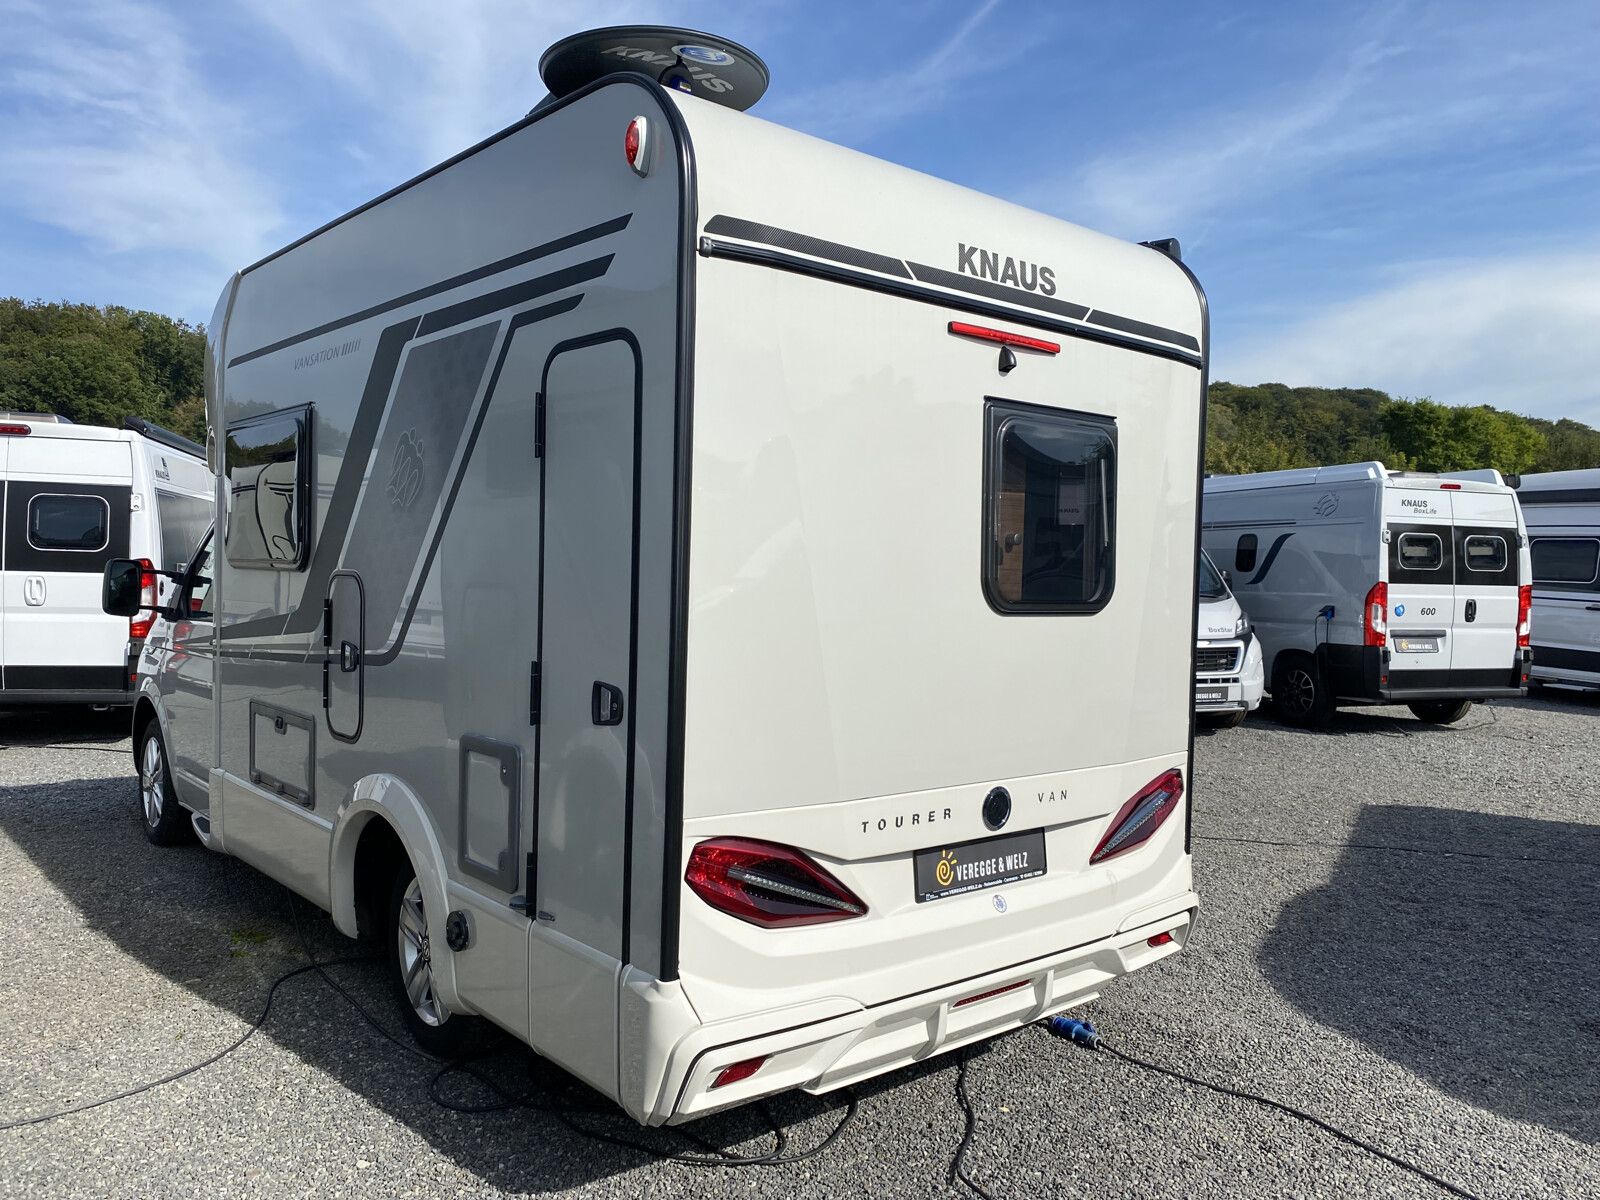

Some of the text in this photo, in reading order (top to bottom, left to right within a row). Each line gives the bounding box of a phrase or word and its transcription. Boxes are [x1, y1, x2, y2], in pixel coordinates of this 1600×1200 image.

[958, 242, 1056, 296] KNAUS
[294, 346, 340, 371] VANSATION
[1401, 499, 1428, 508] KNAUS
[1413, 507, 1437, 515] BoxLife
[1420, 607, 1436, 616] 600
[861, 789, 1067, 834] TOURER VAN
[956, 851, 1029, 882] VEREGGE & WELZ
